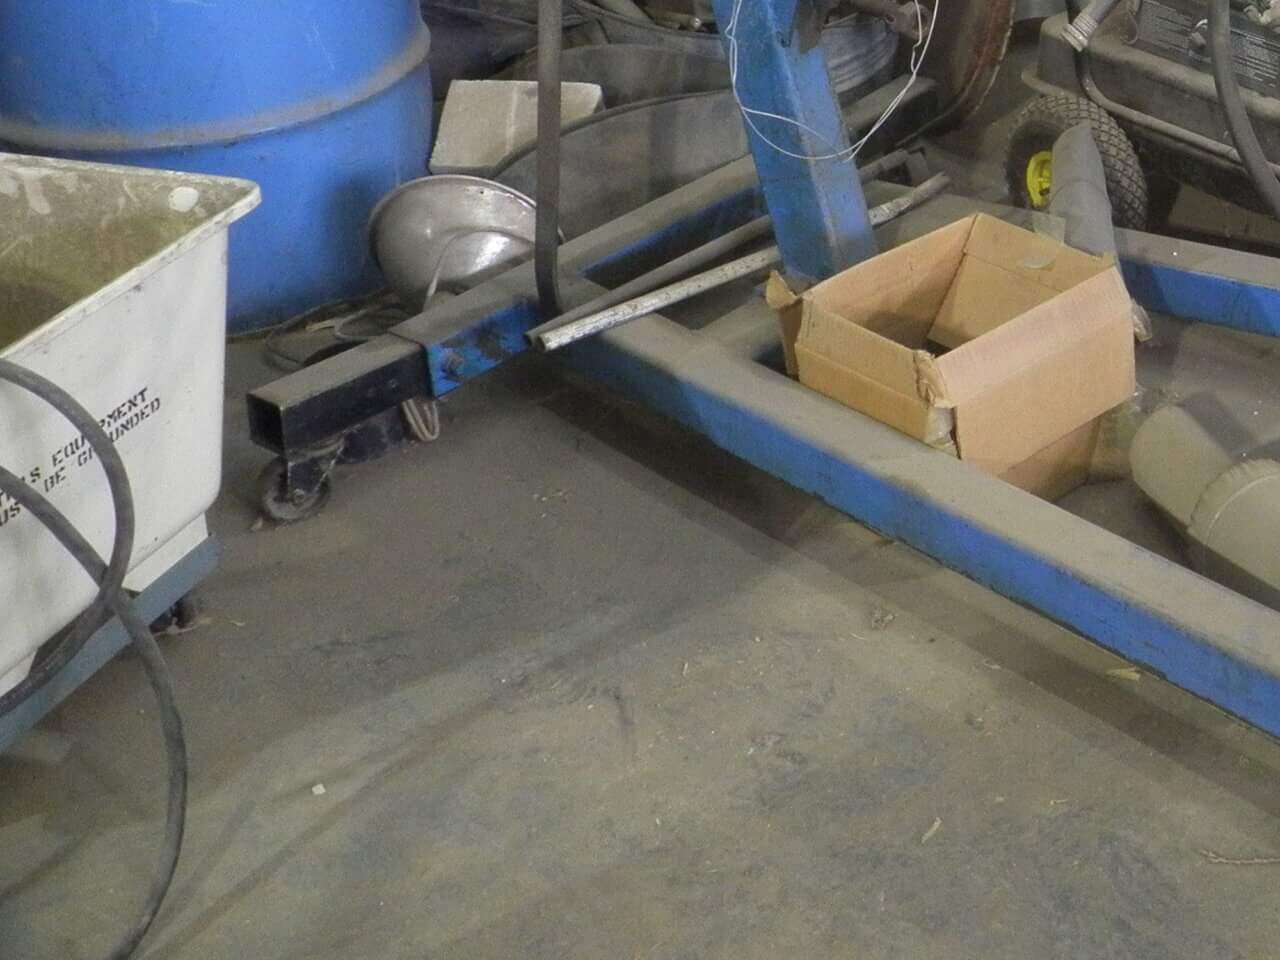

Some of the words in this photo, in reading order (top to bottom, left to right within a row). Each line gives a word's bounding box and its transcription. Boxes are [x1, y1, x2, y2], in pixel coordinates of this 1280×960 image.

[44, 465, 67, 493] BE
[77, 396, 161, 468] GUNDED
[52, 386, 149, 468] EQUPMENT
